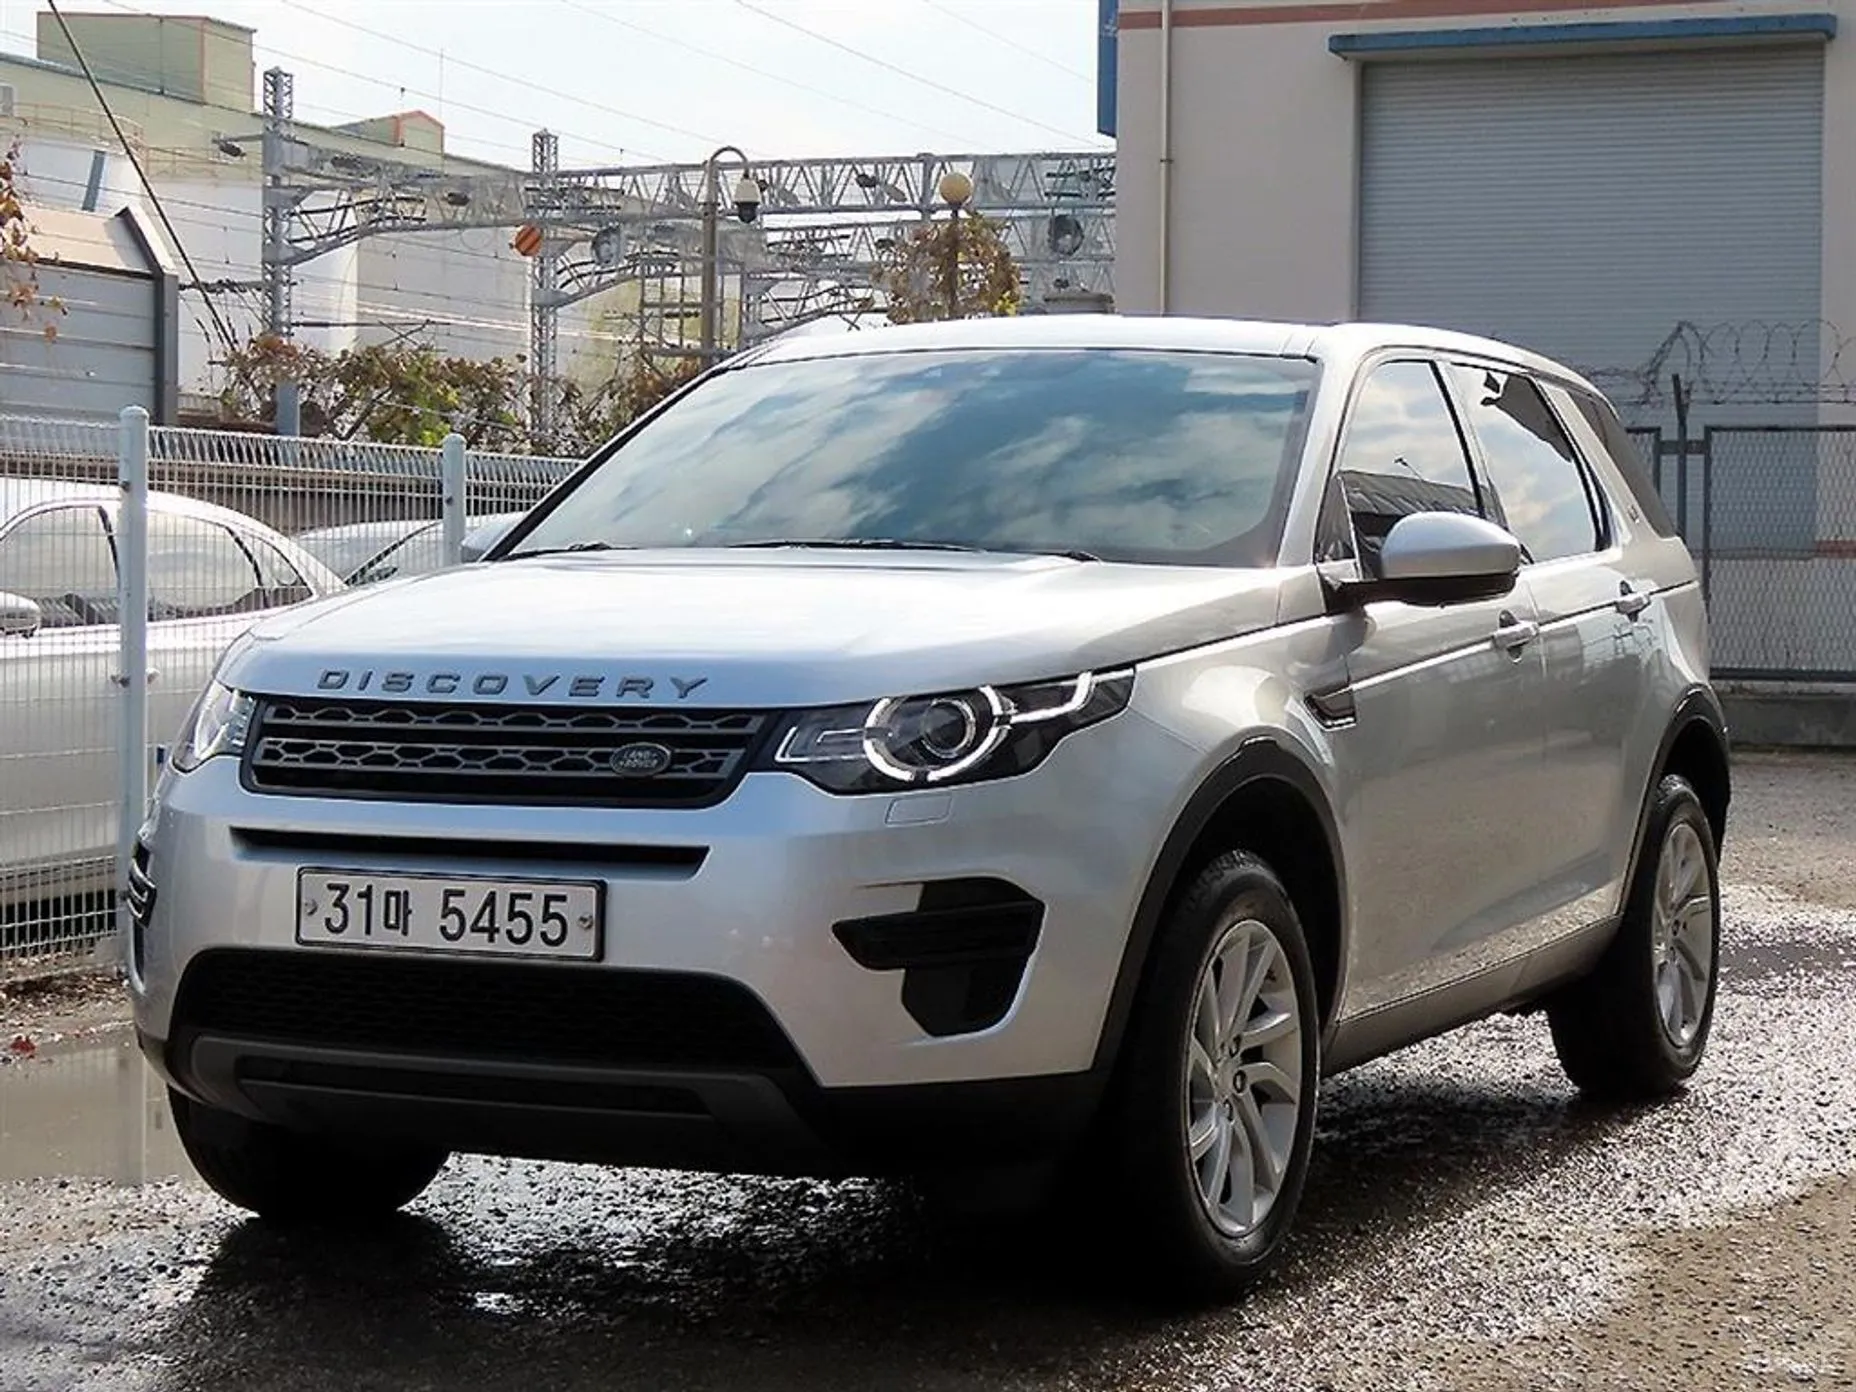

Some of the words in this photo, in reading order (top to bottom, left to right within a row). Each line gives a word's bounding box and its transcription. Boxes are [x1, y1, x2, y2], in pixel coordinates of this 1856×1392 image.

[317, 670, 707, 699] DISCOVERY
[324, 883, 413, 937] 31마
[439, 888, 568, 947] 5455
